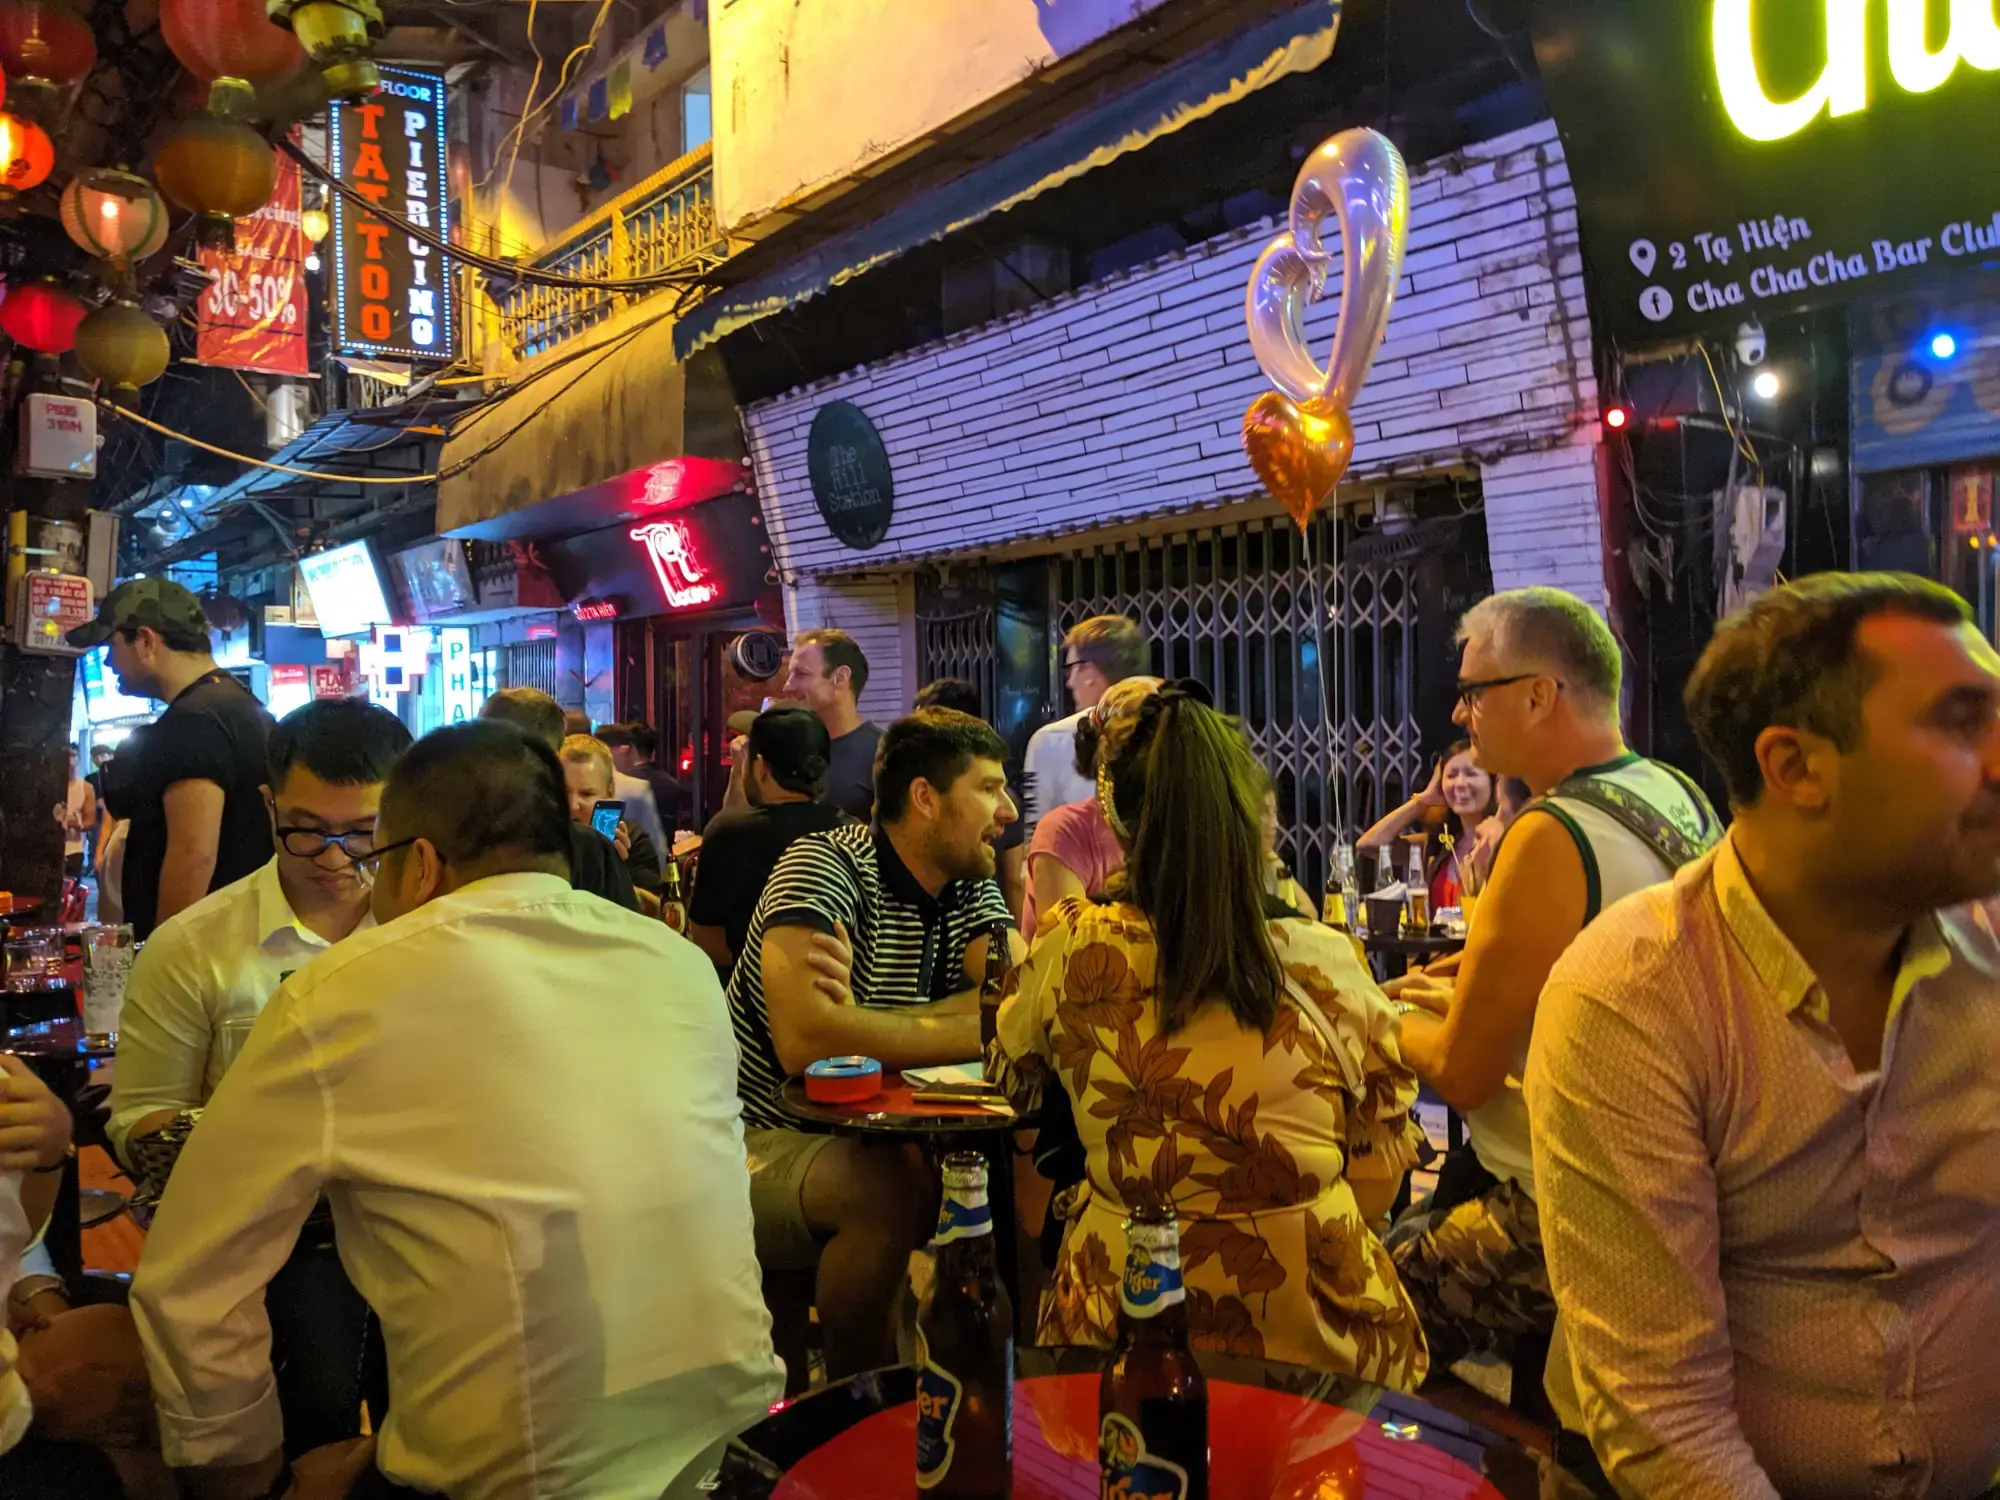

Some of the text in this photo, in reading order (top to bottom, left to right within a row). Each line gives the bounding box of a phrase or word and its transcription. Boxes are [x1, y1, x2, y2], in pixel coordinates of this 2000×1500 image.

[381, 79, 431, 102] FLOOR
[352, 104, 391, 340] TATTOO
[404, 110, 434, 345] PIERCING
[1668, 213, 1812, 270] 2 Tạ Hiện
[236, 242, 272, 259] SALE
[1687, 279, 1745, 312] Cha
[1871, 236, 1932, 273] Bar
[208, 268, 296, 324] 30-50%
[829, 445, 857, 467] The
[831, 461, 868, 491] Hill
[828, 487, 882, 513] Station
